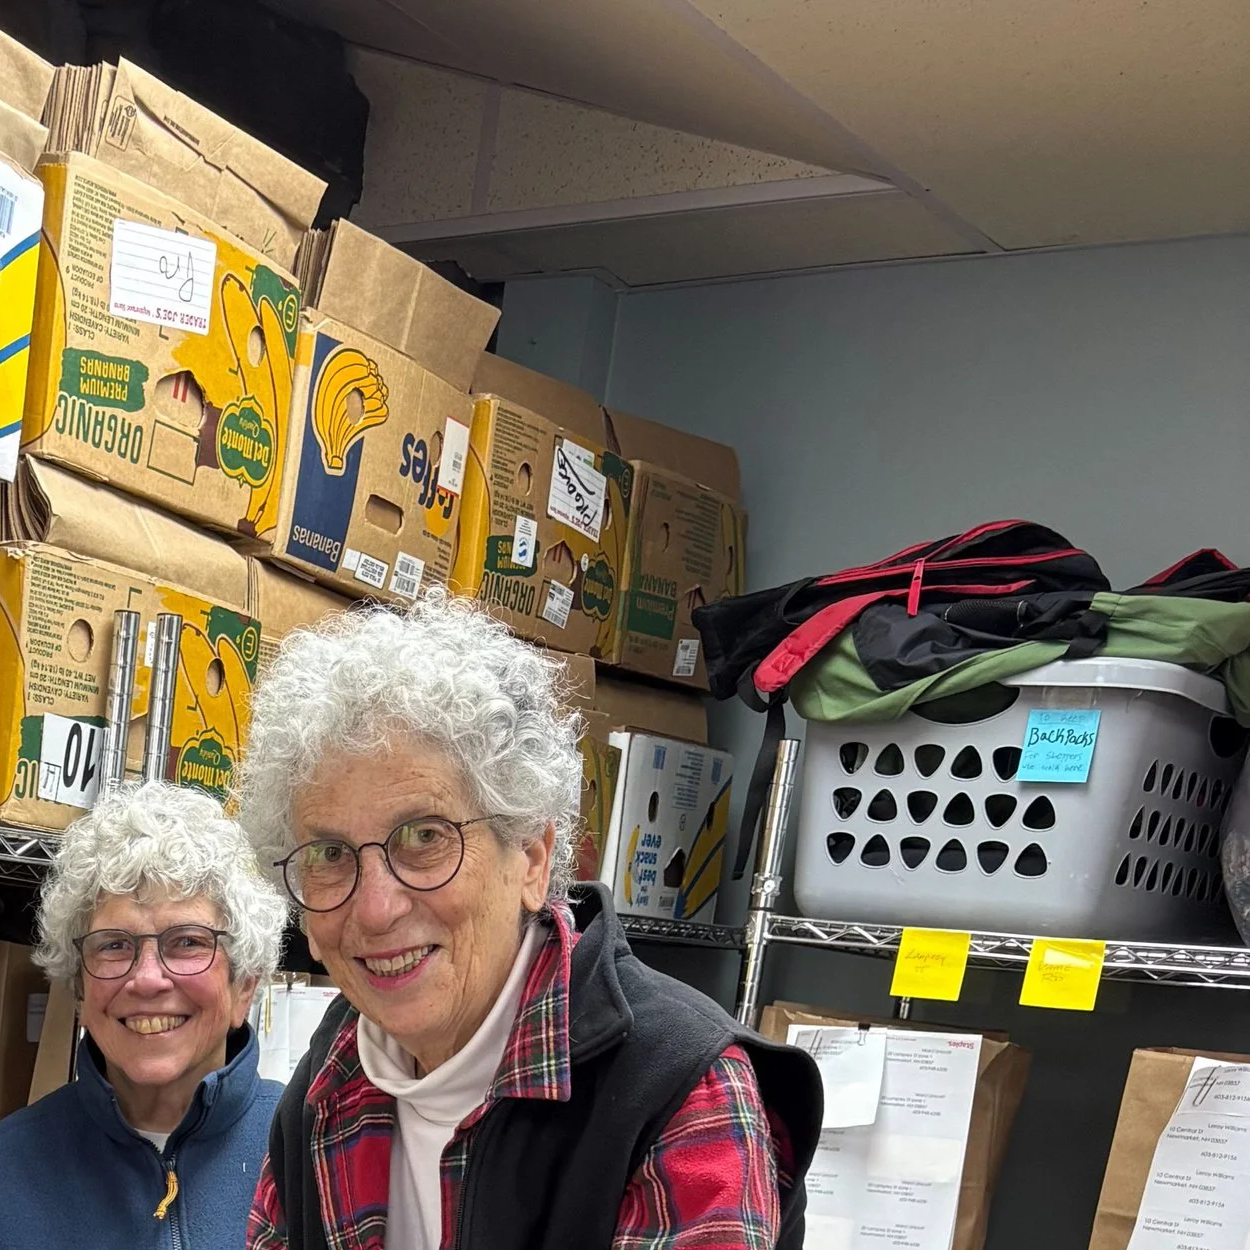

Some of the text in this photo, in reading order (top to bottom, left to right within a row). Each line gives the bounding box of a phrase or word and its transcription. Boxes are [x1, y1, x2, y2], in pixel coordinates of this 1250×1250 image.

[80, 356, 130, 382] BANANAS
[79, 377, 128, 401] PREMIUM
[55, 393, 143, 464] ORGANIC
[222, 427, 269, 467] Del Monte
[292, 525, 341, 563] Bananas
[480, 571, 535, 616] ORGANIC
[181, 760, 214, 784] Monte
[641, 833, 661, 850] ever
